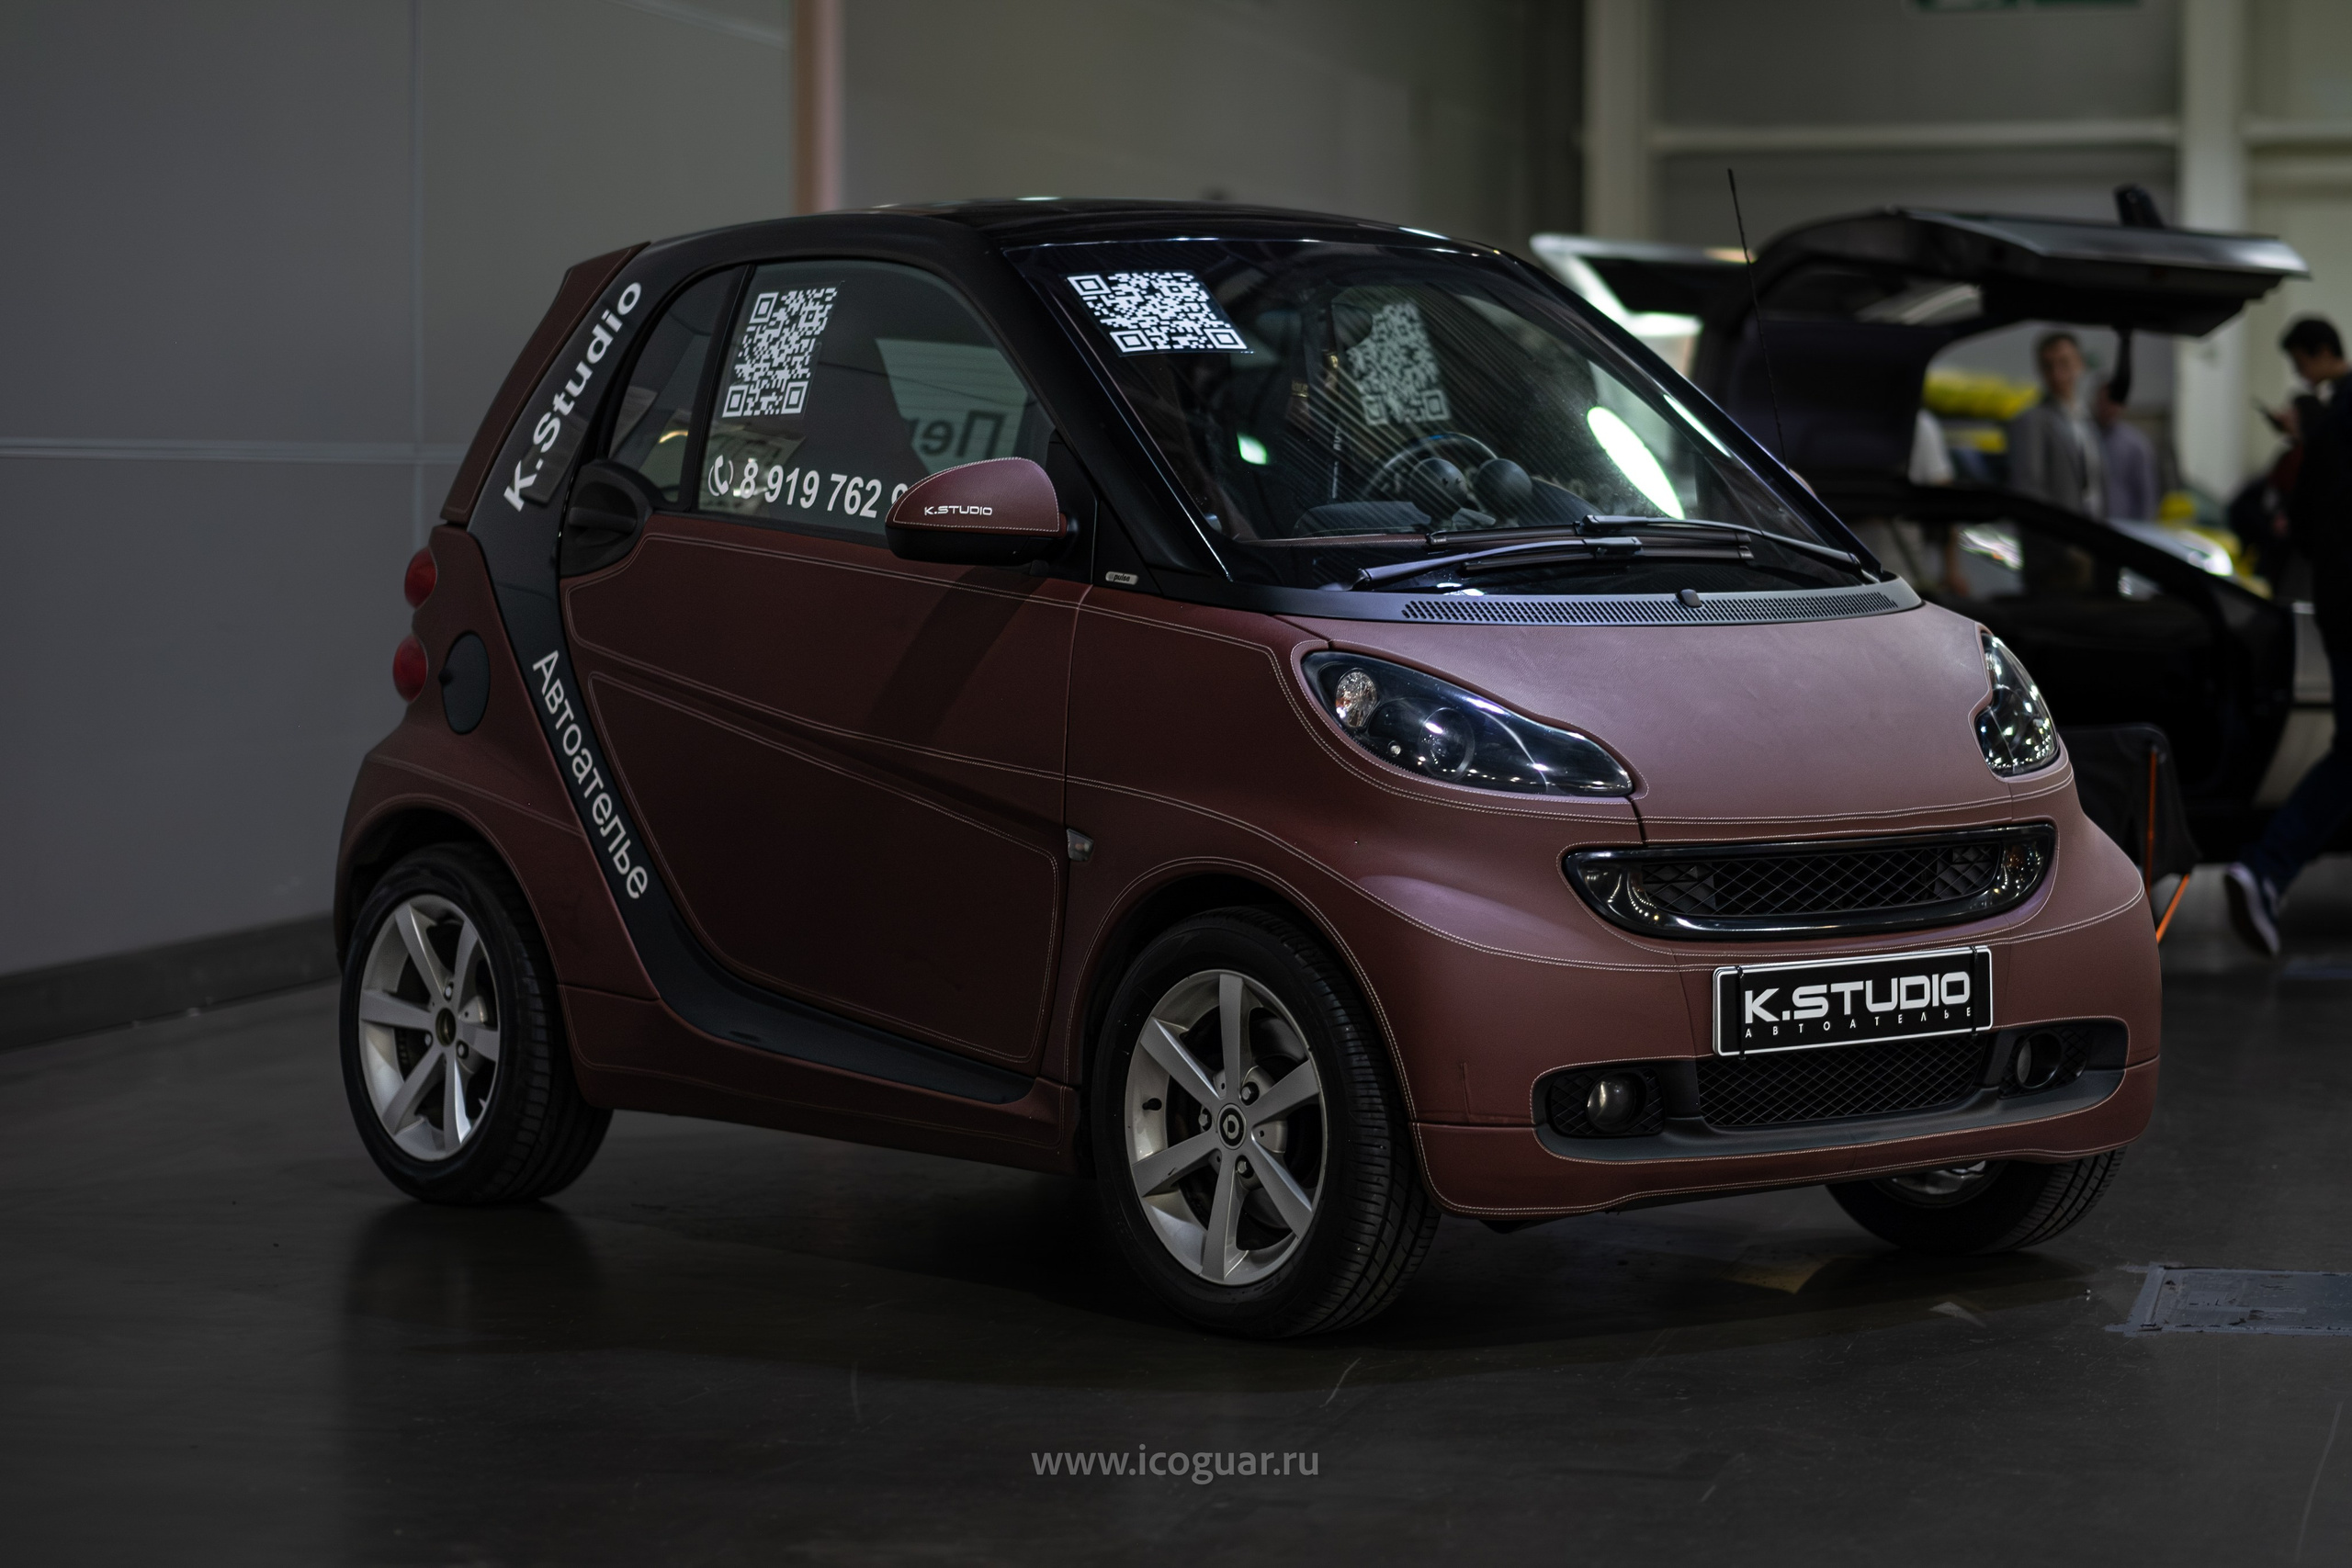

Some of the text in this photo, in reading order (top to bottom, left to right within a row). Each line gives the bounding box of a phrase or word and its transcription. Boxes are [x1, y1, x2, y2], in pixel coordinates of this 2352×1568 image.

[503, 282, 642, 513] K.Studio
[739, 461, 759, 499] 8
[764, 465, 820, 509] 919
[827, 473, 882, 518] 762
[923, 505, 993, 516] K.STUDIO
[532, 649, 649, 899] Автоателье
[1745, 971, 1971, 1024] K.STUDIO
[1746, 1007, 1972, 1039] АВТОАТЕЛЬЕ
